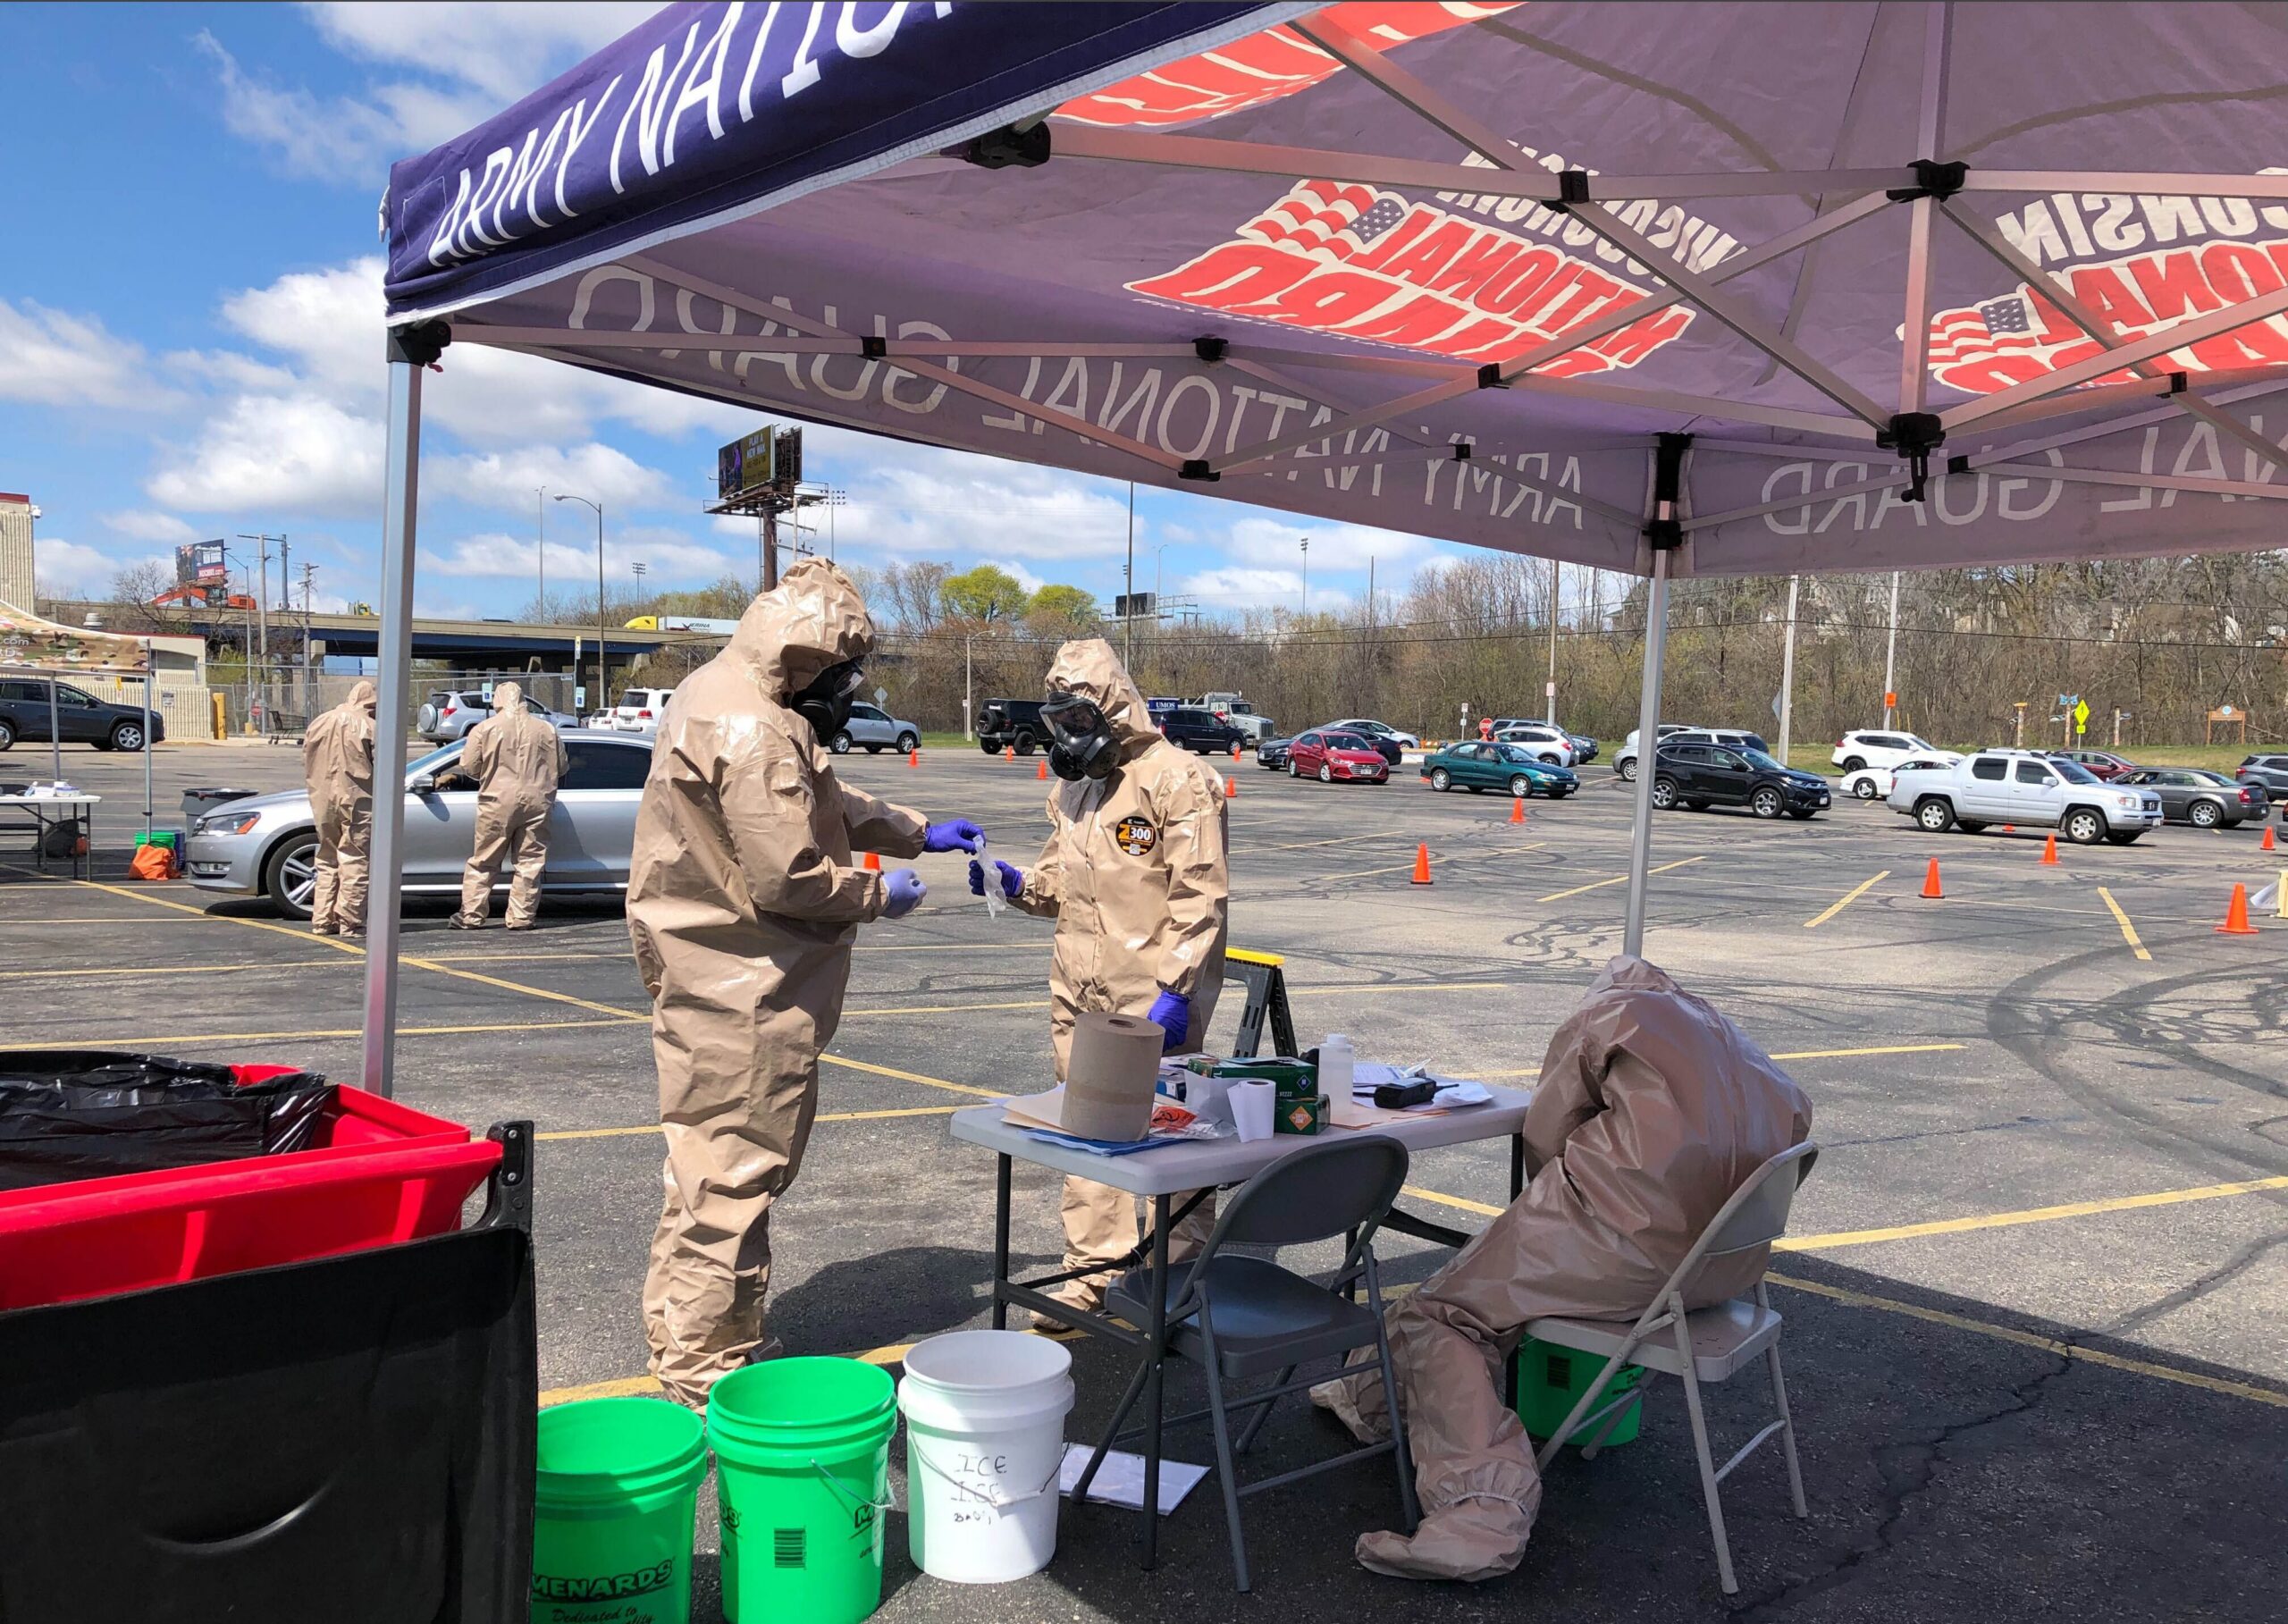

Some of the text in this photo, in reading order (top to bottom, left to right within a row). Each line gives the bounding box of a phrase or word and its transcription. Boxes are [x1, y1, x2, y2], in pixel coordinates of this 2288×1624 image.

[428, 75, 622, 267] ARMY
[954, 1454, 1007, 1477] ICE
[532, 1559, 673, 1598] MENARDS
